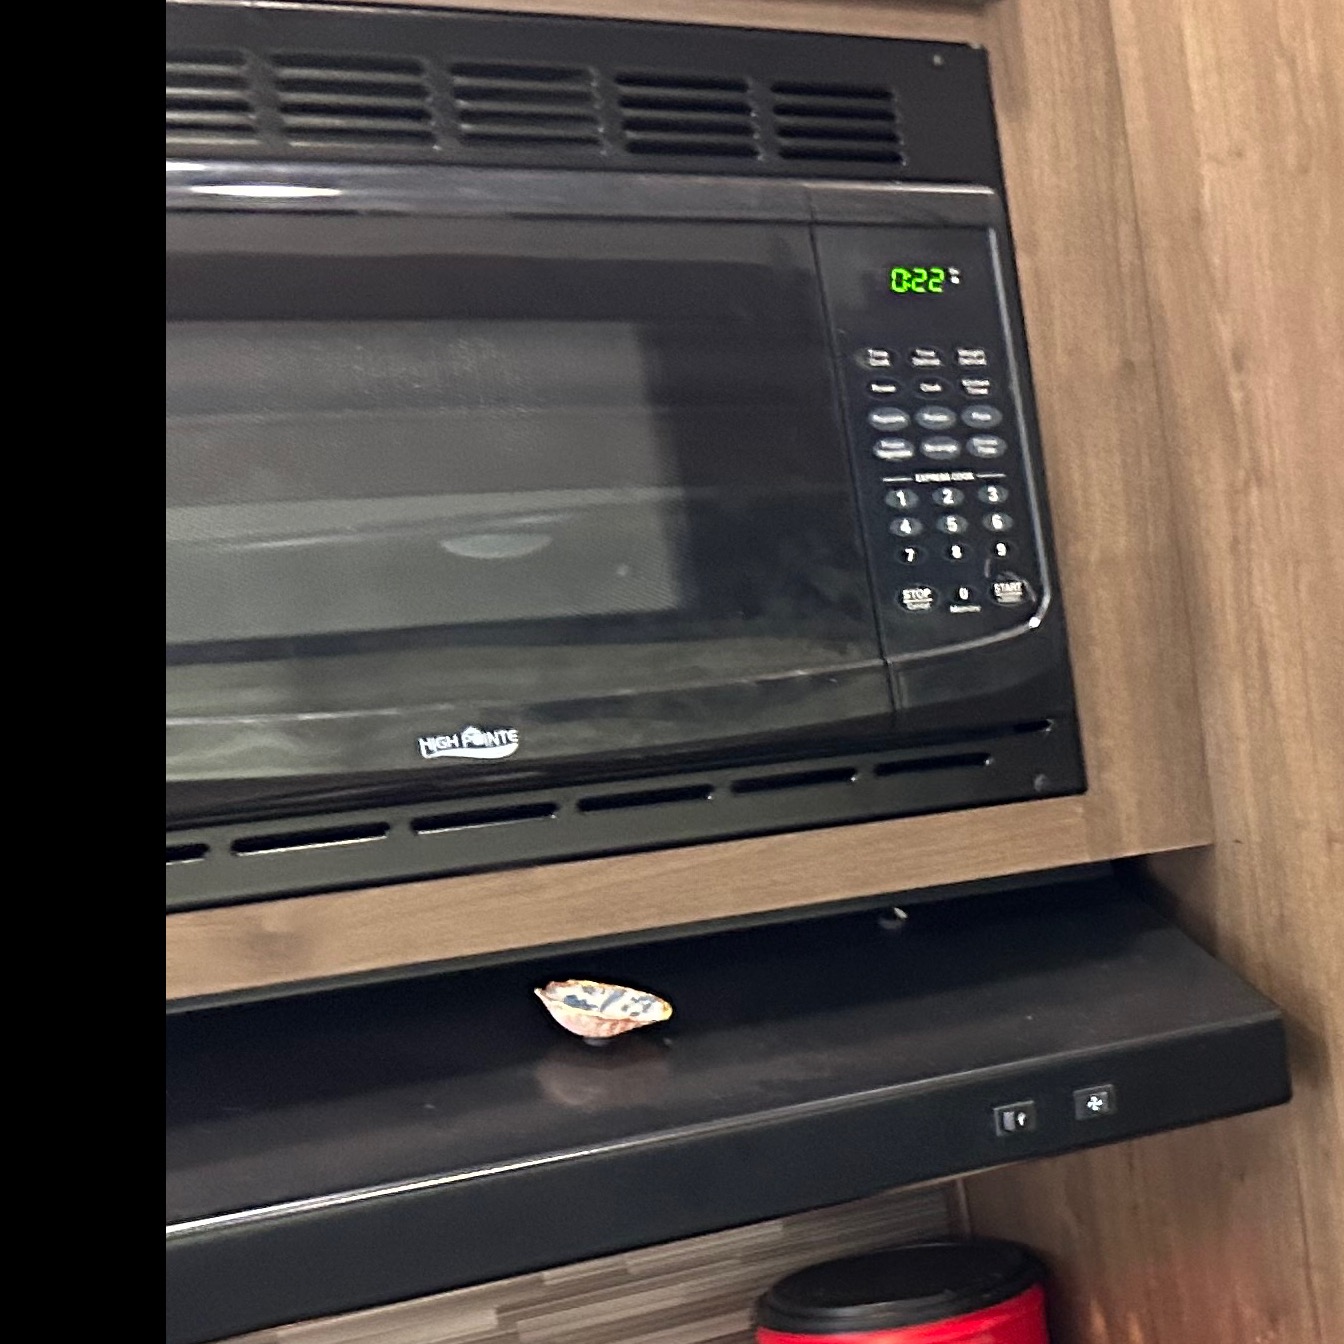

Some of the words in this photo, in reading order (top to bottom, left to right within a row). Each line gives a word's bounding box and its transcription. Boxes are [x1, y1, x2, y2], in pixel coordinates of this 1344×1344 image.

[896, 489, 907, 507] 1
[942, 487, 955, 505] 2
[987, 485, 999, 502] 3
[900, 518, 912, 534] 4
[946, 515, 958, 532] 5
[991, 513, 1003, 530] 6
[905, 547, 915, 562] 7
[951, 544, 963, 559] 8
[996, 542, 1007, 557] 9
[902, 587, 932, 600] STOP
[959, 587, 969, 600] 0
[993, 581, 1022, 595] START
[418, 733, 459, 754] HIGH
